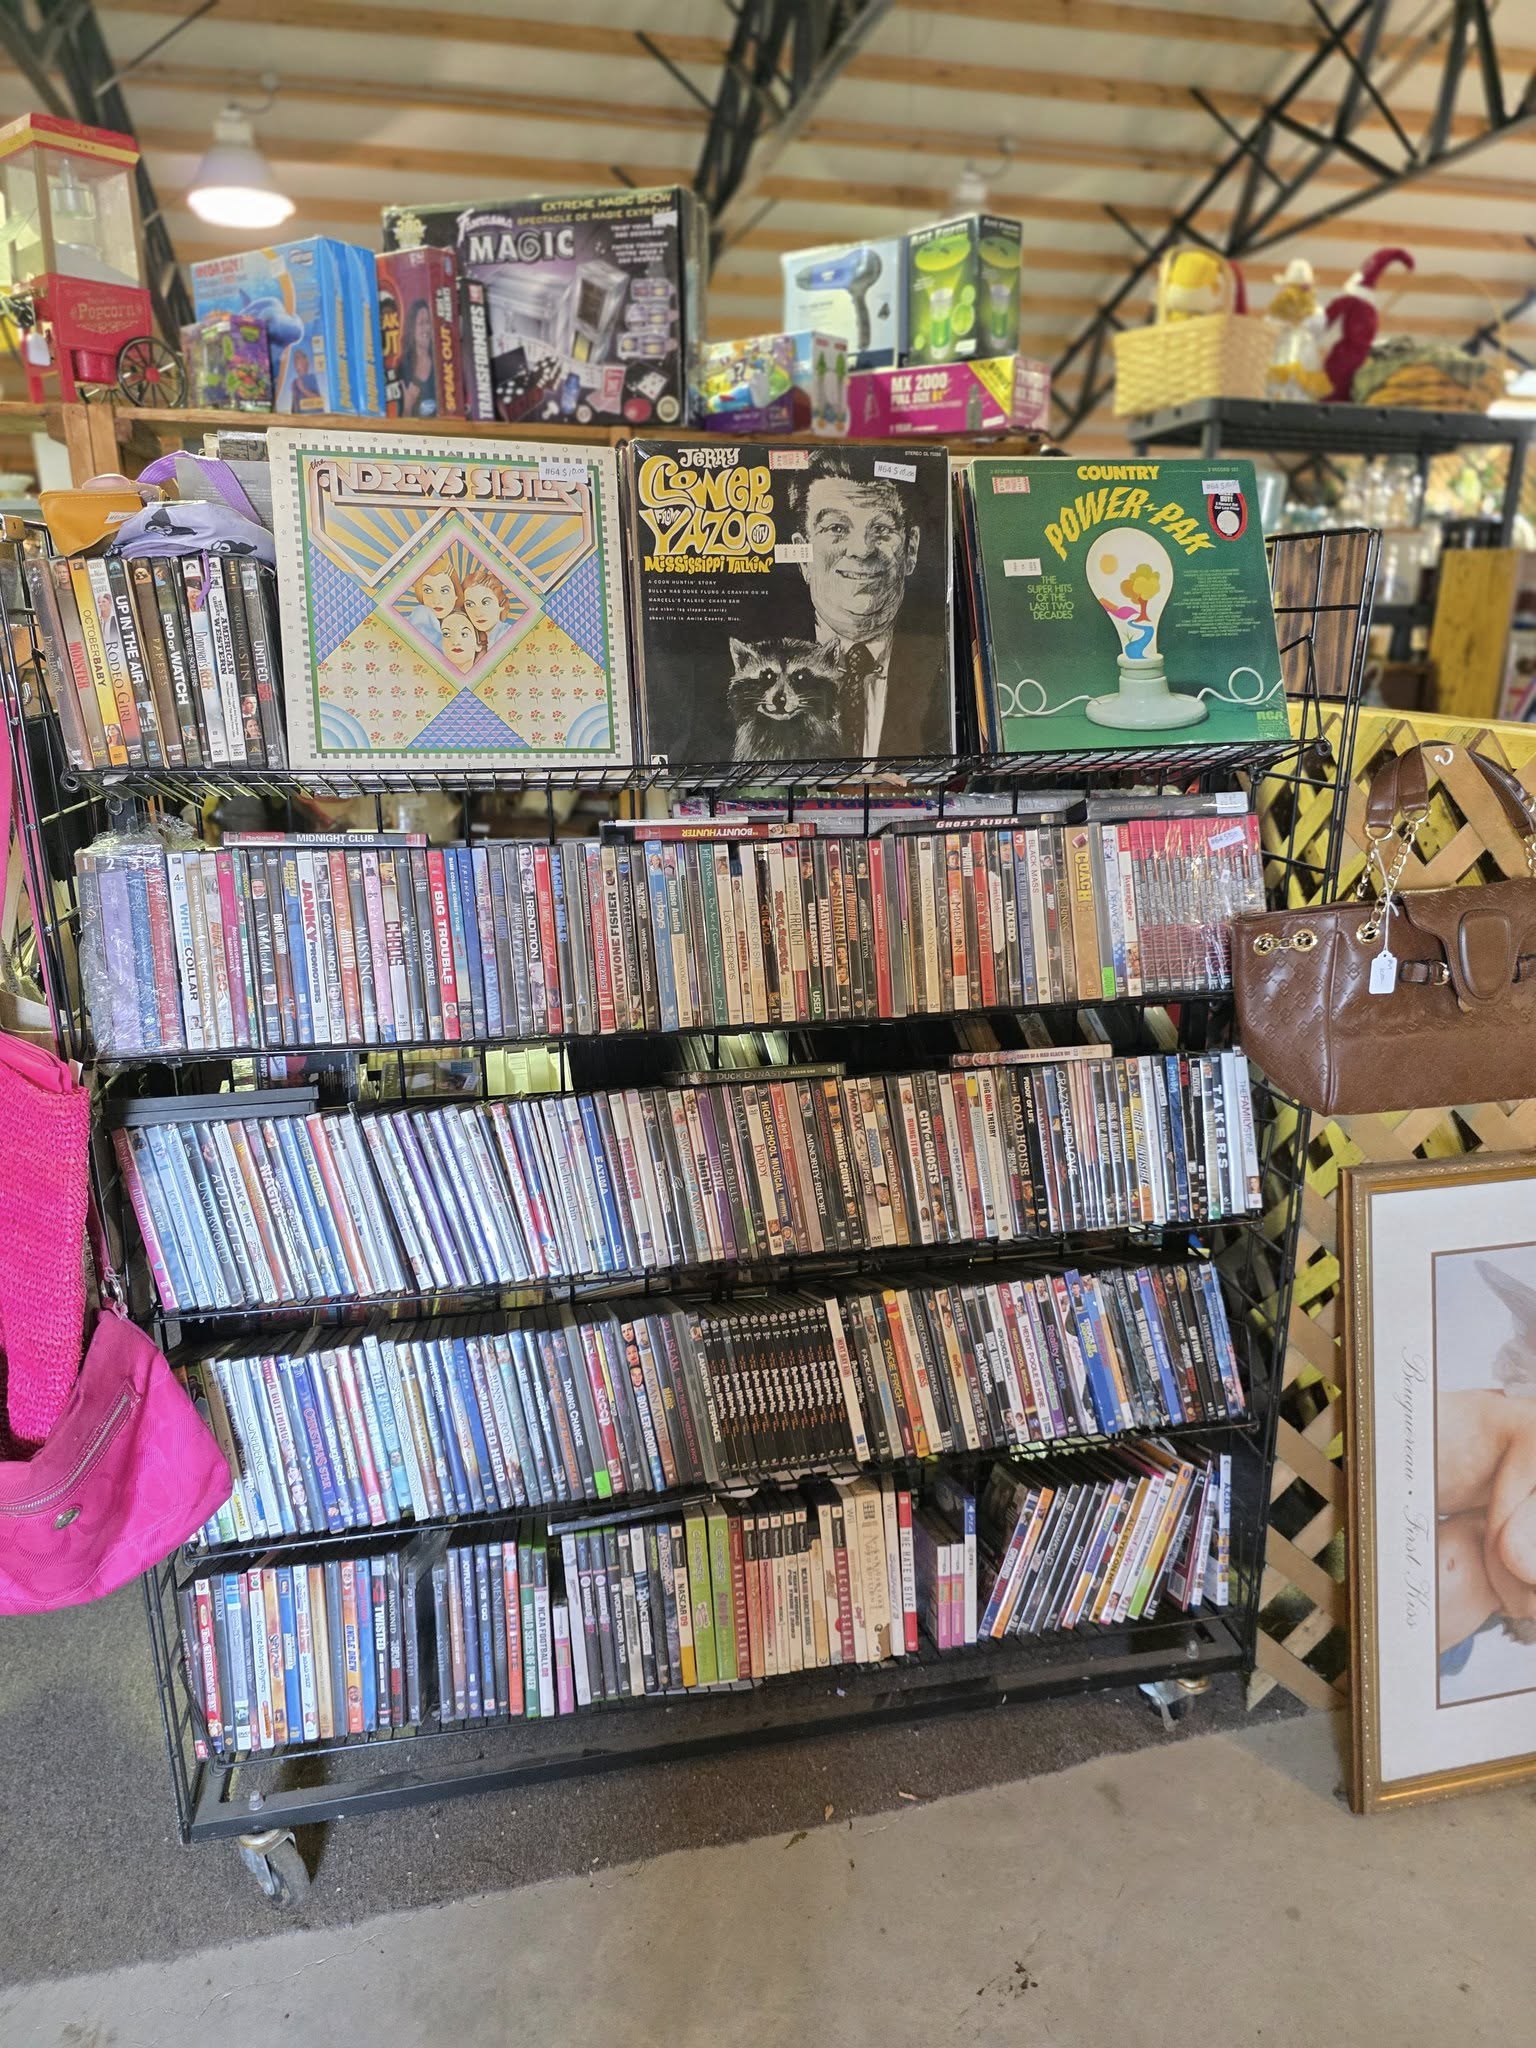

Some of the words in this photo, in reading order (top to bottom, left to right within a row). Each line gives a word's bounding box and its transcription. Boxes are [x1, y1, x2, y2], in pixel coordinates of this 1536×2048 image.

[517, 216, 572, 225] SPECTACLE
[575, 212, 588, 222] DE
[592, 210, 623, 220] MAGIE
[542, 200, 595, 212] EXTREME
[469, 228, 575, 263] MAGIC
[911, 234, 932, 246] Ant
[935, 222, 969, 239] Farm
[78, 302, 134, 318] Popcorn
[440, 325, 455, 356] OUT
[470, 305, 495, 420] TRANSFORMERS
[445, 359, 457, 410] SPEAK
[891, 376, 912, 392] MX
[916, 373, 948, 391] 2000
[309, 461, 468, 498] ANDREWS
[545, 468, 560, 476] #64
[878, 465, 892, 473] #64
[1077, 465, 1159, 480] COUNTRY
[639, 508, 776, 556] YAZOO
[656, 508, 681, 524] FROM
[1044, 486, 1149, 561] POWER
[752, 525, 769, 543] CITY
[1027, 585, 1052, 593] SUPER
[1055, 584, 1072, 593] HITS
[1041, 576, 1056, 584] THE
[115, 595, 129, 614] UP
[212, 596, 220, 616] GREAT
[1030, 602, 1049, 611] LAST
[1052, 601, 1074, 610] TWO
[1036, 594, 1048, 602] OF
[1050, 593, 1065, 601] THE
[119, 616, 133, 630] IN
[1033, 611, 1073, 620] DECADES
[123, 634, 140, 660] THE
[163, 613, 176, 639] END
[170, 651, 189, 705] WATCH
[213, 617, 228, 675] WESTERN
[221, 617, 235, 675] AMERICAN
[254, 640, 268, 682] UNITED
[69, 641, 90, 689] MONSTER
[129, 661, 144, 685] AIR
[238, 652, 251, 682] SIN
[106, 641, 124, 689] RODEO
[115, 691, 131, 723] GIRL
[1257, 711, 1283, 720] RCA
[296, 834, 346, 843] MIDNIGHT
[348, 835, 375, 843] CLUB
[936, 819, 979, 829] GHOST
[980, 817, 1019, 826] RIDER
[1028, 840, 1037, 868] BLACK
[1074, 852, 1092, 902] COACH
[301, 880, 317, 942] JANKY
[434, 890, 444, 916] BIG
[607, 892, 620, 936] FISHER
[937, 877, 949, 945] FLYBOYS
[723, 910, 733, 933] Love
[790, 913, 804, 946] FRENCH
[355, 926, 373, 985] MISSING
[437, 919, 453, 984] TROUBLE
[727, 935, 737, 980] Happens
[611, 939, 625, 1002] ANTWONE
[812, 990, 821, 1014] USED
[717, 1072, 742, 1080] DUCK
[744, 1069, 789, 1079] DYNASTY
[1055, 1070, 1069, 1107] CRAZY
[761, 1101, 771, 1124] HIGH
[1011, 1095, 1024, 1130] ROAD
[1026, 1099, 1033, 1108] OF
[1027, 1109, 1035, 1123] LIFE
[765, 1124, 777, 1157] SCHOOL
[1212, 1084, 1228, 1169] TAKERS
[754, 1144, 768, 1177] BUDDY
[919, 1110, 931, 1134] CITY
[925, 1141, 939, 1184] GHOSTS
[1016, 1134, 1030, 1176] HOUSE
[307, 1162, 324, 1208] FIGURES
[678, 1132, 695, 1185] SWEPT
[689, 1191, 705, 1231] AWAY
[721, 1142, 730, 1163] ZILL
[726, 1168, 739, 1203] DRILLS
[769, 1158, 783, 1193] MUSICAL
[807, 1133, 820, 1179] MINORITY
[814, 1181, 826, 1216] REPORT
[839, 1160, 851, 1198] COUNTY
[199, 1182, 230, 1265] UNDERWORLD
[212, 1174, 246, 1265] ADDICTED
[976, 1343, 986, 1363] Bad
[1023, 1325, 1034, 1351] HENRY
[1189, 1326, 1203, 1363] CAPTIVITY
[861, 1348, 875, 1393] FACE/OFF
[883, 1339, 896, 1372] STAGE
[1028, 1352, 1039, 1378] POOLE
[1048, 1324, 1060, 1358] Reality
[1056, 1365, 1067, 1390] Love
[563, 1378, 577, 1410] TAKING
[889, 1373, 904, 1409] FRIGHT
[916, 1369, 929, 1388] BOSS
[979, 1363, 993, 1394] Words
[637, 1395, 652, 1429] BOILER
[697, 1352, 711, 1398] LAKEVIEW
[708, 1400, 721, 1443] TERRACE
[1036, 1388, 1045, 1408] HERE
[569, 1410, 584, 1447] CHANCE
[644, 1430, 658, 1457] ROOM
[247, 1417, 264, 1475] CONFIDENCE
[491, 1449, 505, 1482] HERO
[901, 1530, 911, 1548] THE
[1402, 1504, 1429, 1568] First
[902, 1551, 912, 1574] HATE
[677, 1584, 687, 1615] NASCAR
[904, 1585, 914, 1608] GIVE
[1404, 1570, 1431, 1628] Kiss
[375, 1605, 386, 1650] TWISTED
[523, 1604, 532, 1629] WORLD
[538, 1607, 546, 1627] NCAA
[613, 1594, 621, 1618] WORLD
[619, 1644, 627, 1664] TOUR
[681, 1616, 689, 1627] 09
[525, 1630, 534, 1656] SERIES
[540, 1628, 549, 1666] FOOTBALL
[526, 1657, 535, 1666] OF
[542, 1666, 549, 1677] 08
[527, 1667, 536, 1690] POKER
